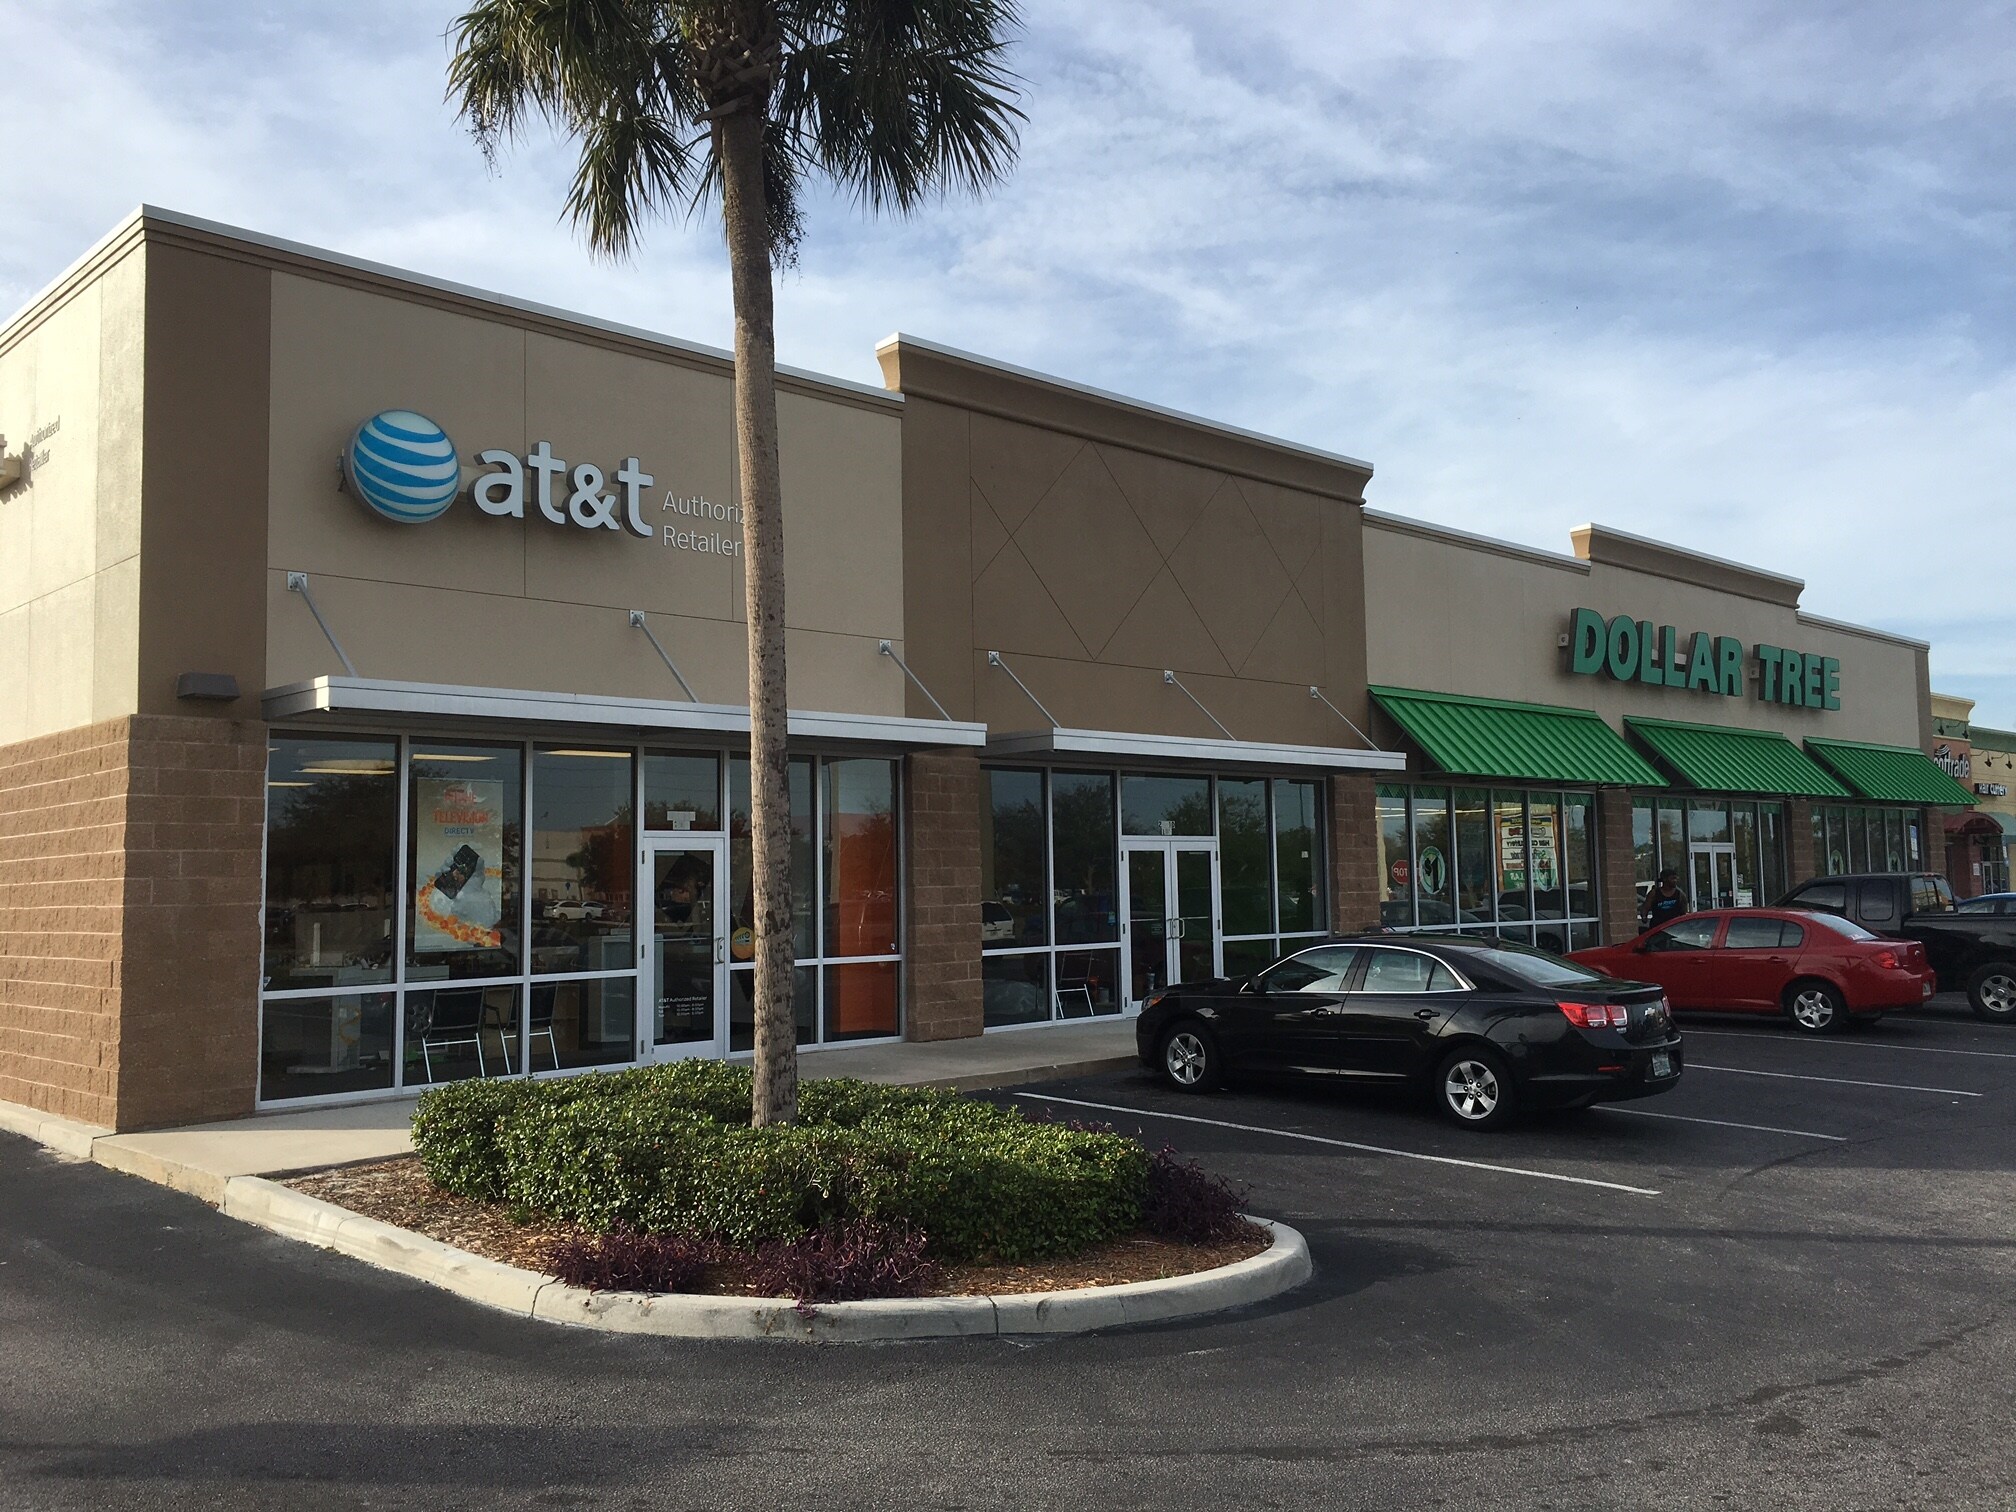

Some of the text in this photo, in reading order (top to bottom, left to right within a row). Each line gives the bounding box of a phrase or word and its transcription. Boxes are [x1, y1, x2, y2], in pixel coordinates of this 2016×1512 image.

[467, 440, 654, 538] at&t
[662, 490, 745, 525] Authoriz
[663, 525, 742, 557] Retailer
[1571, 607, 1841, 711] DOLLAR TREE
